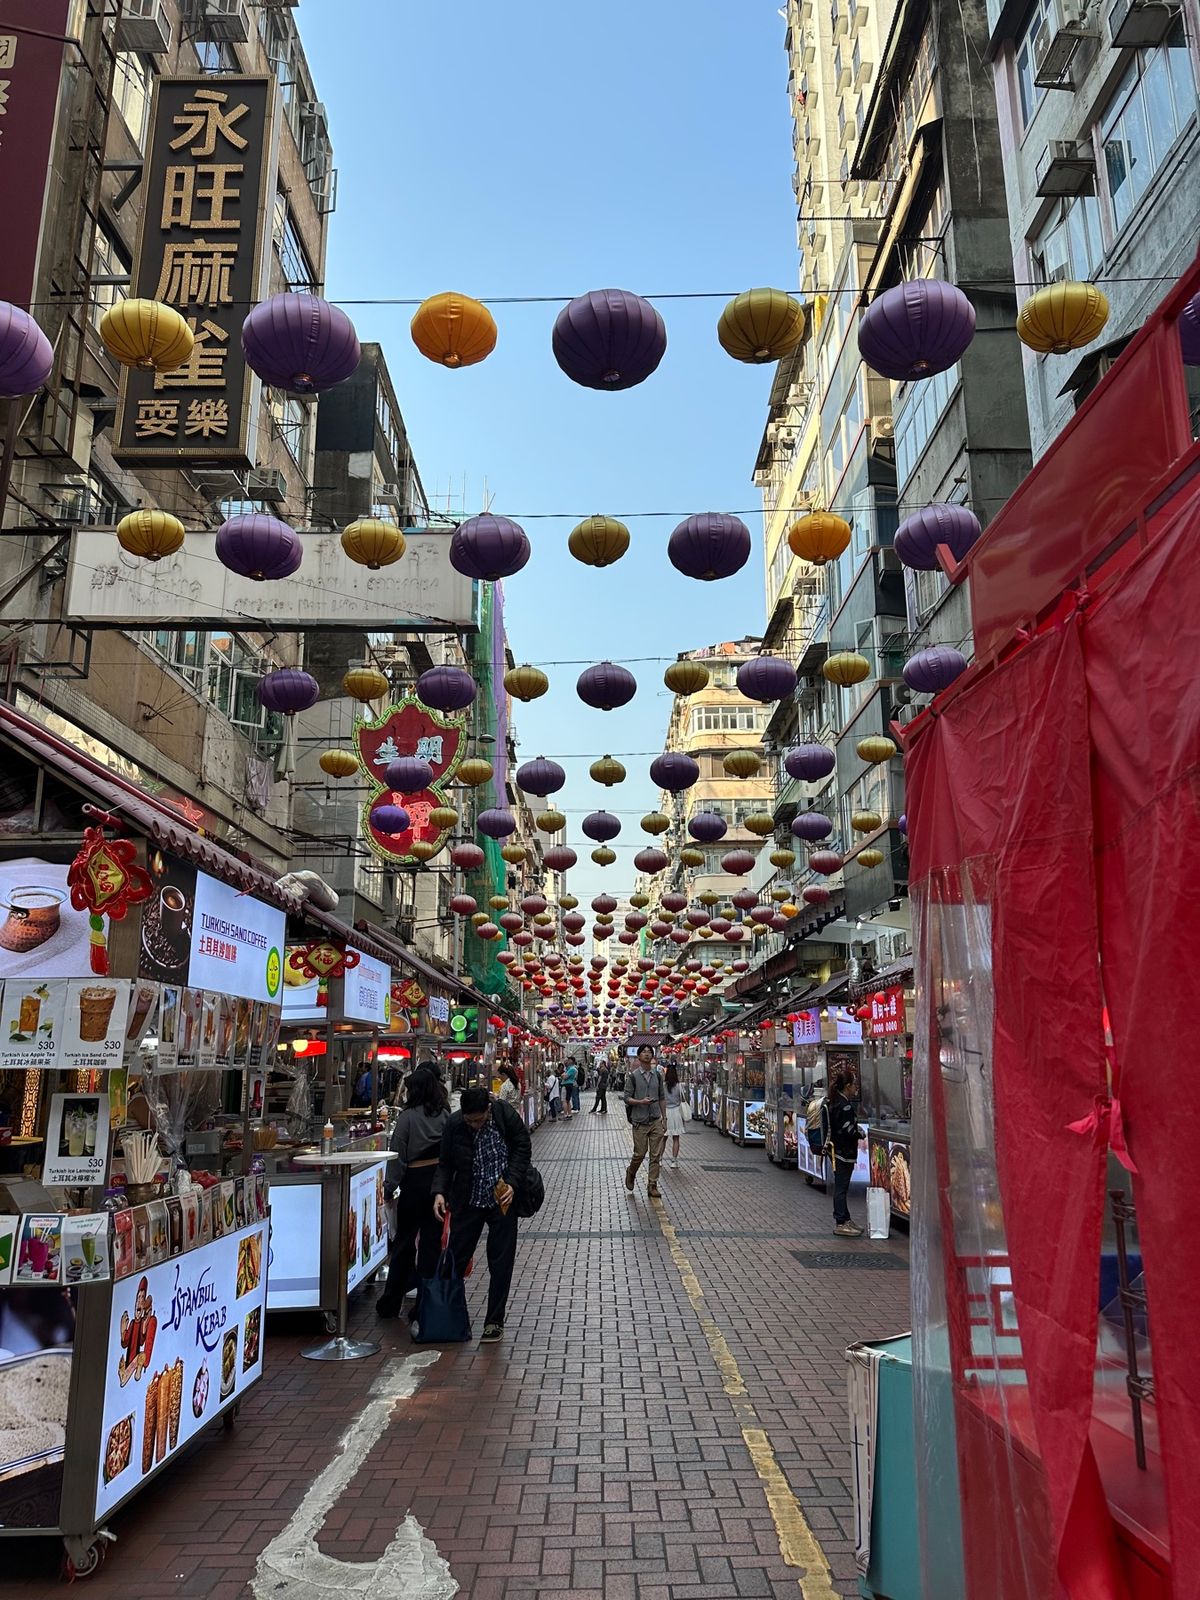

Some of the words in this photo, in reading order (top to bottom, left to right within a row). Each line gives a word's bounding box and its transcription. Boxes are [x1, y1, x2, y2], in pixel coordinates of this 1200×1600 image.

[153, 88, 250, 391] 永旺麻雀
[201, 913, 231, 935] TURKISH
[231, 924, 248, 941] SAND
[247, 930, 267, 949] COFFEE
[314, 947, 334, 965] 福
[38, 1040, 55, 1050] $30
[104, 1040, 121, 1050] $30
[88, 1158, 104, 1168] $30
[196, 1305, 227, 1352] KEBAB
